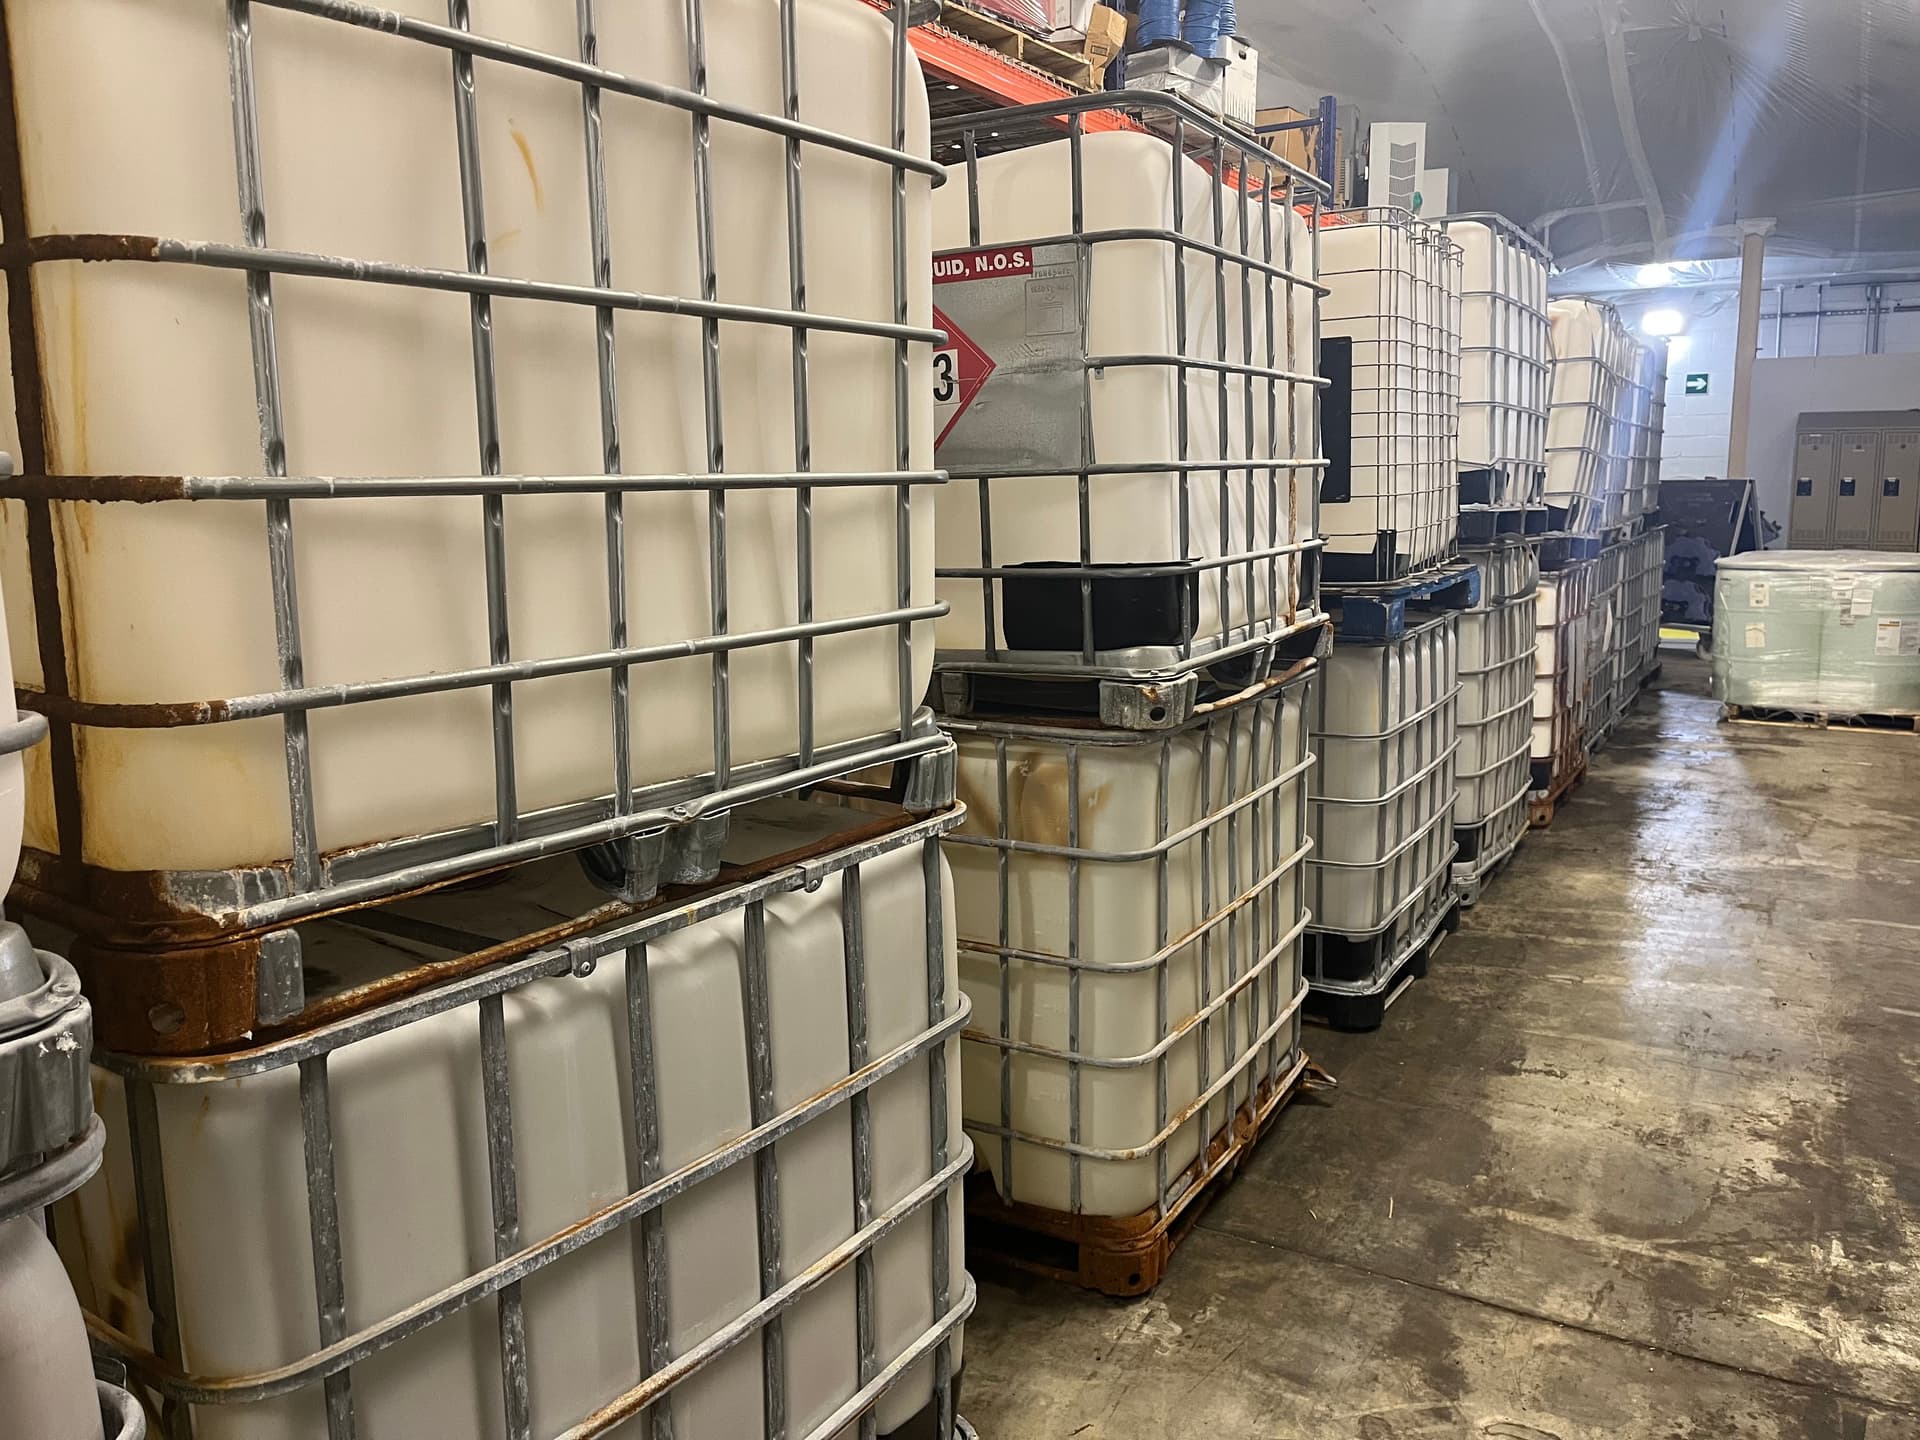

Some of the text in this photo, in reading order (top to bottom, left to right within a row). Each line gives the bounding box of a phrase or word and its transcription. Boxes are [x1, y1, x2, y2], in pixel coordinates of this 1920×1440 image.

[933, 251, 1030, 277] UID, N.O.S.
[933, 353, 954, 402] 3
